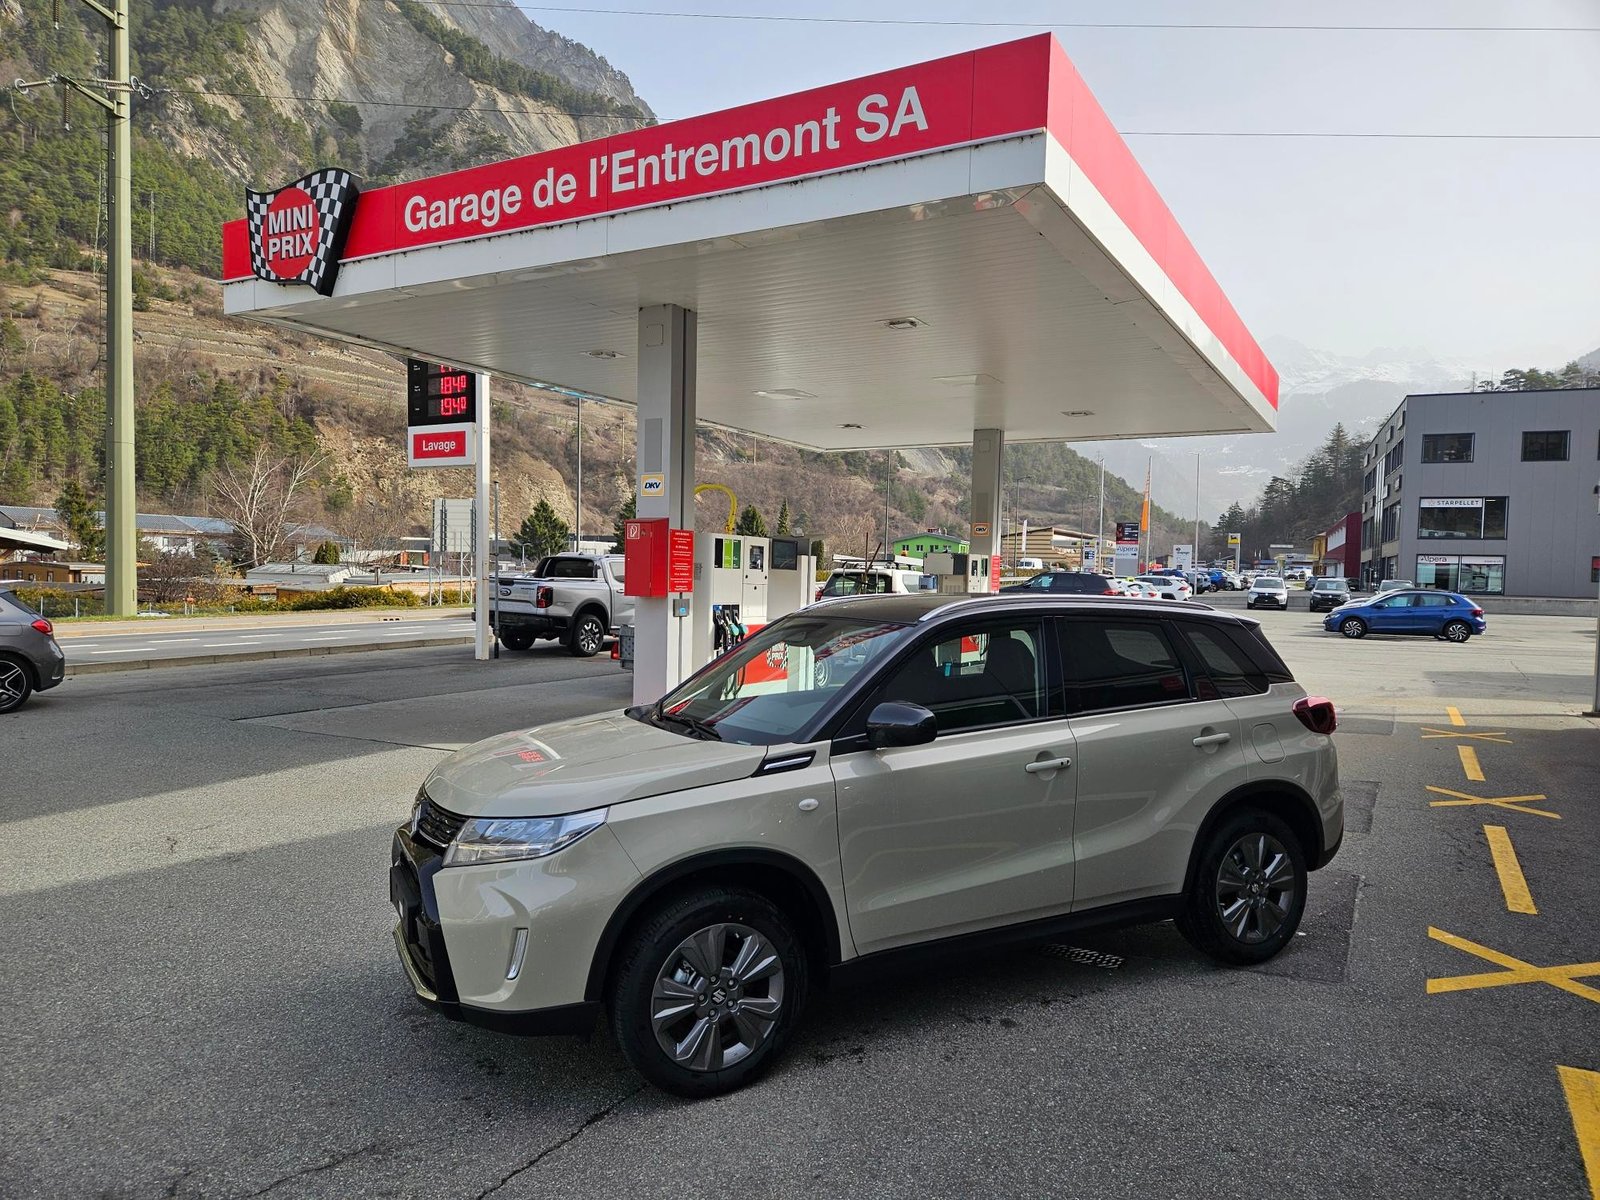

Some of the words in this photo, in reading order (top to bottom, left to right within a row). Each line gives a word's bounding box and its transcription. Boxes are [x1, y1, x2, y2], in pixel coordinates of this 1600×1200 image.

[404, 195, 522, 233] Garage
[532, 167, 577, 208] de
[589, 106, 841, 198] l'Entremont
[855, 85, 928, 143] SA
[268, 203, 313, 236] MINI
[268, 231, 314, 261] PRIX
[422, 440, 456, 452] Lavage
[1420, 555, 1448, 563] Alpera
